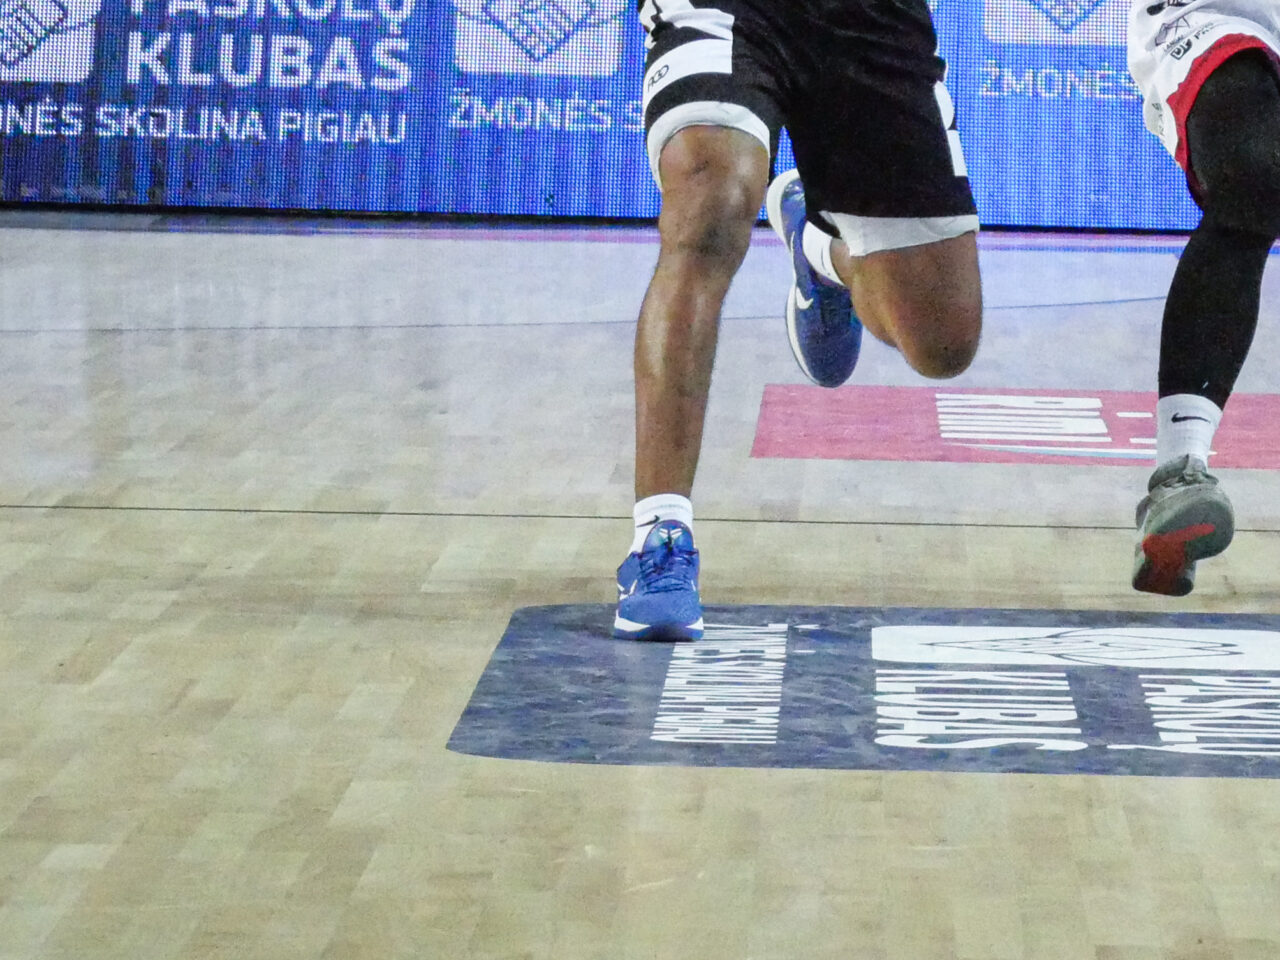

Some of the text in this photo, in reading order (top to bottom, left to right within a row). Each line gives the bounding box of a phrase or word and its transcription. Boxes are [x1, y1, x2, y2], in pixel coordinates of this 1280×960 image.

[126, 30, 412, 91] KLUBAS
[95, 103, 267, 141] SKOLINA
[279, 109, 408, 144] PIGIAU
[449, 87, 613, 132] ŽMONĖS
[873, 668, 1090, 751] KLUBAS
